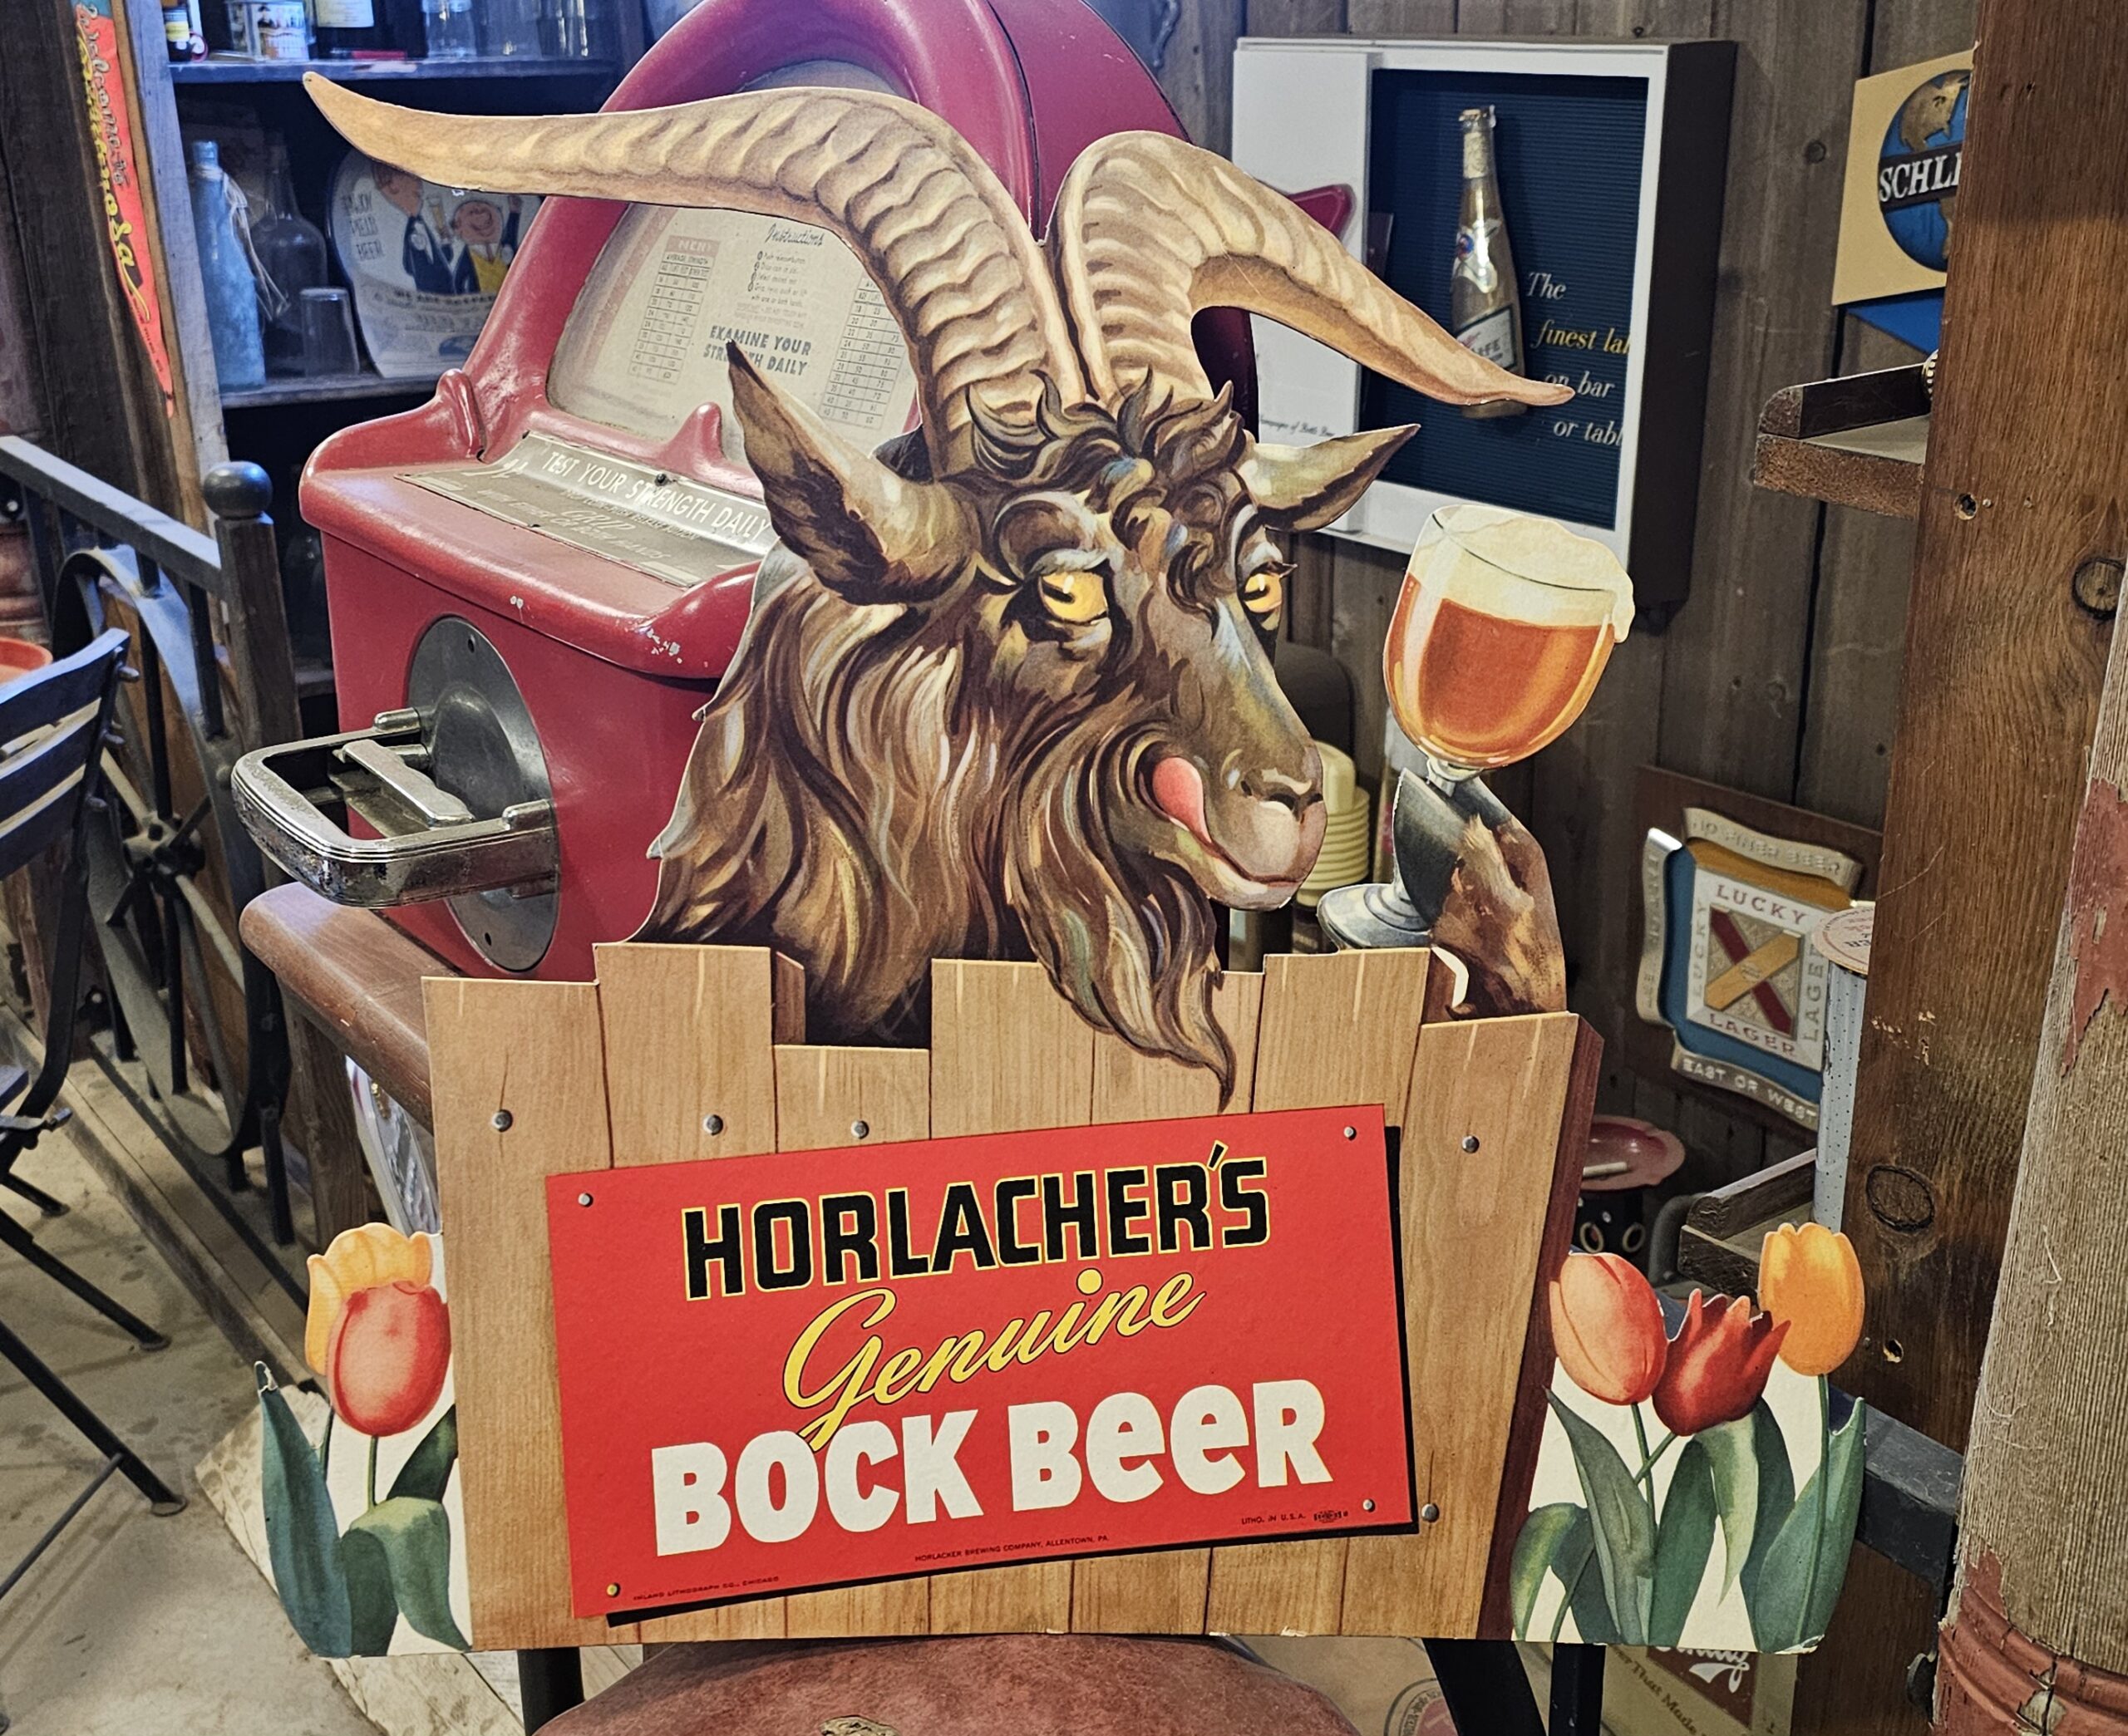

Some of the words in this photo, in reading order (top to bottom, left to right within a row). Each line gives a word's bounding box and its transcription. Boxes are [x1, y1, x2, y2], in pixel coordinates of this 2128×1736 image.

[1527, 272, 1567, 300] The
[709, 325, 770, 348] EXAMINE
[774, 335, 812, 356] YOUR
[1530, 319, 1598, 351] finest
[766, 356, 808, 376] DAILY
[1577, 370, 1615, 398] bar
[1553, 420, 1579, 438] or
[541, 450, 582, 477] TEST
[578, 461, 628, 494] YOUR
[625, 478, 712, 528] STRENGTH
[710, 505, 771, 543] DAILY
[562, 509, 636, 531] GRIP
[1716, 883, 1807, 925] LUCKY
[1709, 1012, 1796, 1057] LAGER
[1682, 1057, 1727, 1081] EAST
[1734, 1075, 1758, 1094] OR
[1766, 1089, 1818, 1124] WEST
[682, 1142, 1271, 1301] HORLACHER'S
[782, 1267, 1205, 1453] Genuine
[651, 1408, 984, 1556] BOCK
[964, 1545, 1001, 1556] BREWING
[1003, 1541, 1043, 1552] COMPANY,
[1045, 1536, 1096, 1547] ALLENTOWN,
[667, 1583, 720, 1597] LITHOGRAPH
[741, 1576, 780, 1587] CHICAGO
[1632, 1660, 1662, 1697] That
[1662, 1693, 1697, 1735] Made
